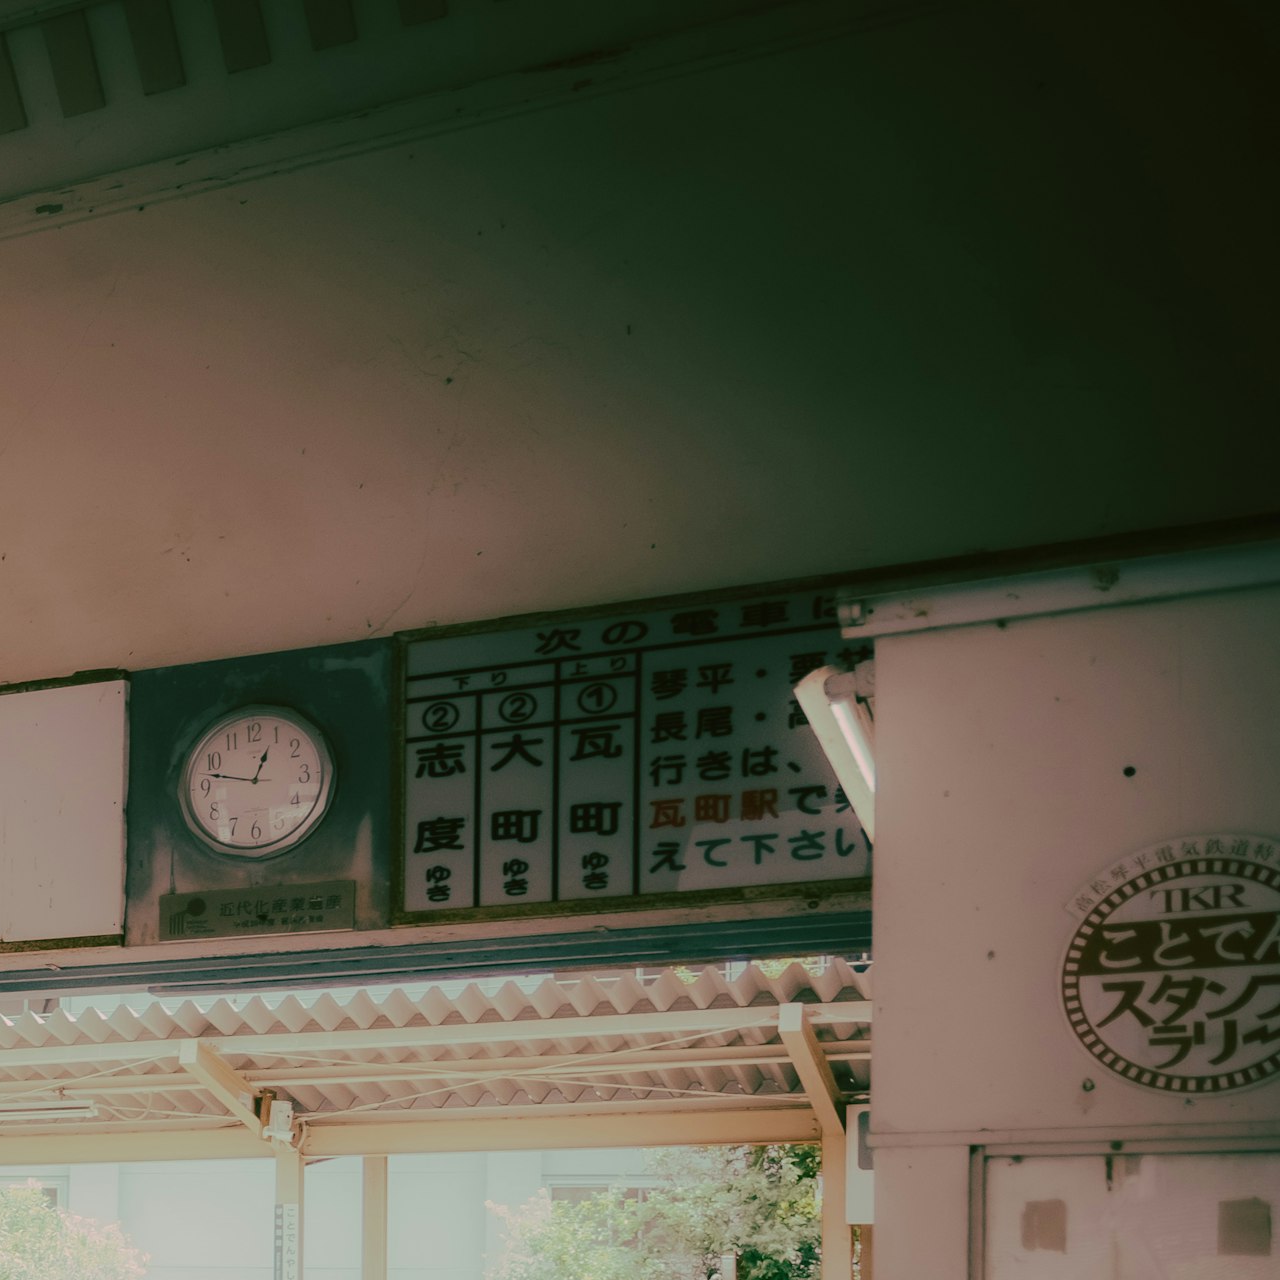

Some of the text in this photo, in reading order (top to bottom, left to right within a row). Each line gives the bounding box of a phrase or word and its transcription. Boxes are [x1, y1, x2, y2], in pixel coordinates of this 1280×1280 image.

[569, 656, 627, 677] 上り
[453, 671, 507, 690] 下り
[226, 732, 237, 751] 11
[245, 722, 262, 743] 12
[273, 726, 279, 744] 1
[290, 738, 301, 758] 2
[208, 751, 222, 771] 10
[649, 746, 801, 787] 行きは、
[298, 763, 311, 784] 3
[200, 778, 211, 799] 9
[290, 791, 301, 808] 4
[209, 801, 220, 821] 8
[228, 817, 239, 837] 7
[250, 820, 262, 840] 6
[1150, 884, 1253, 914] TKR
